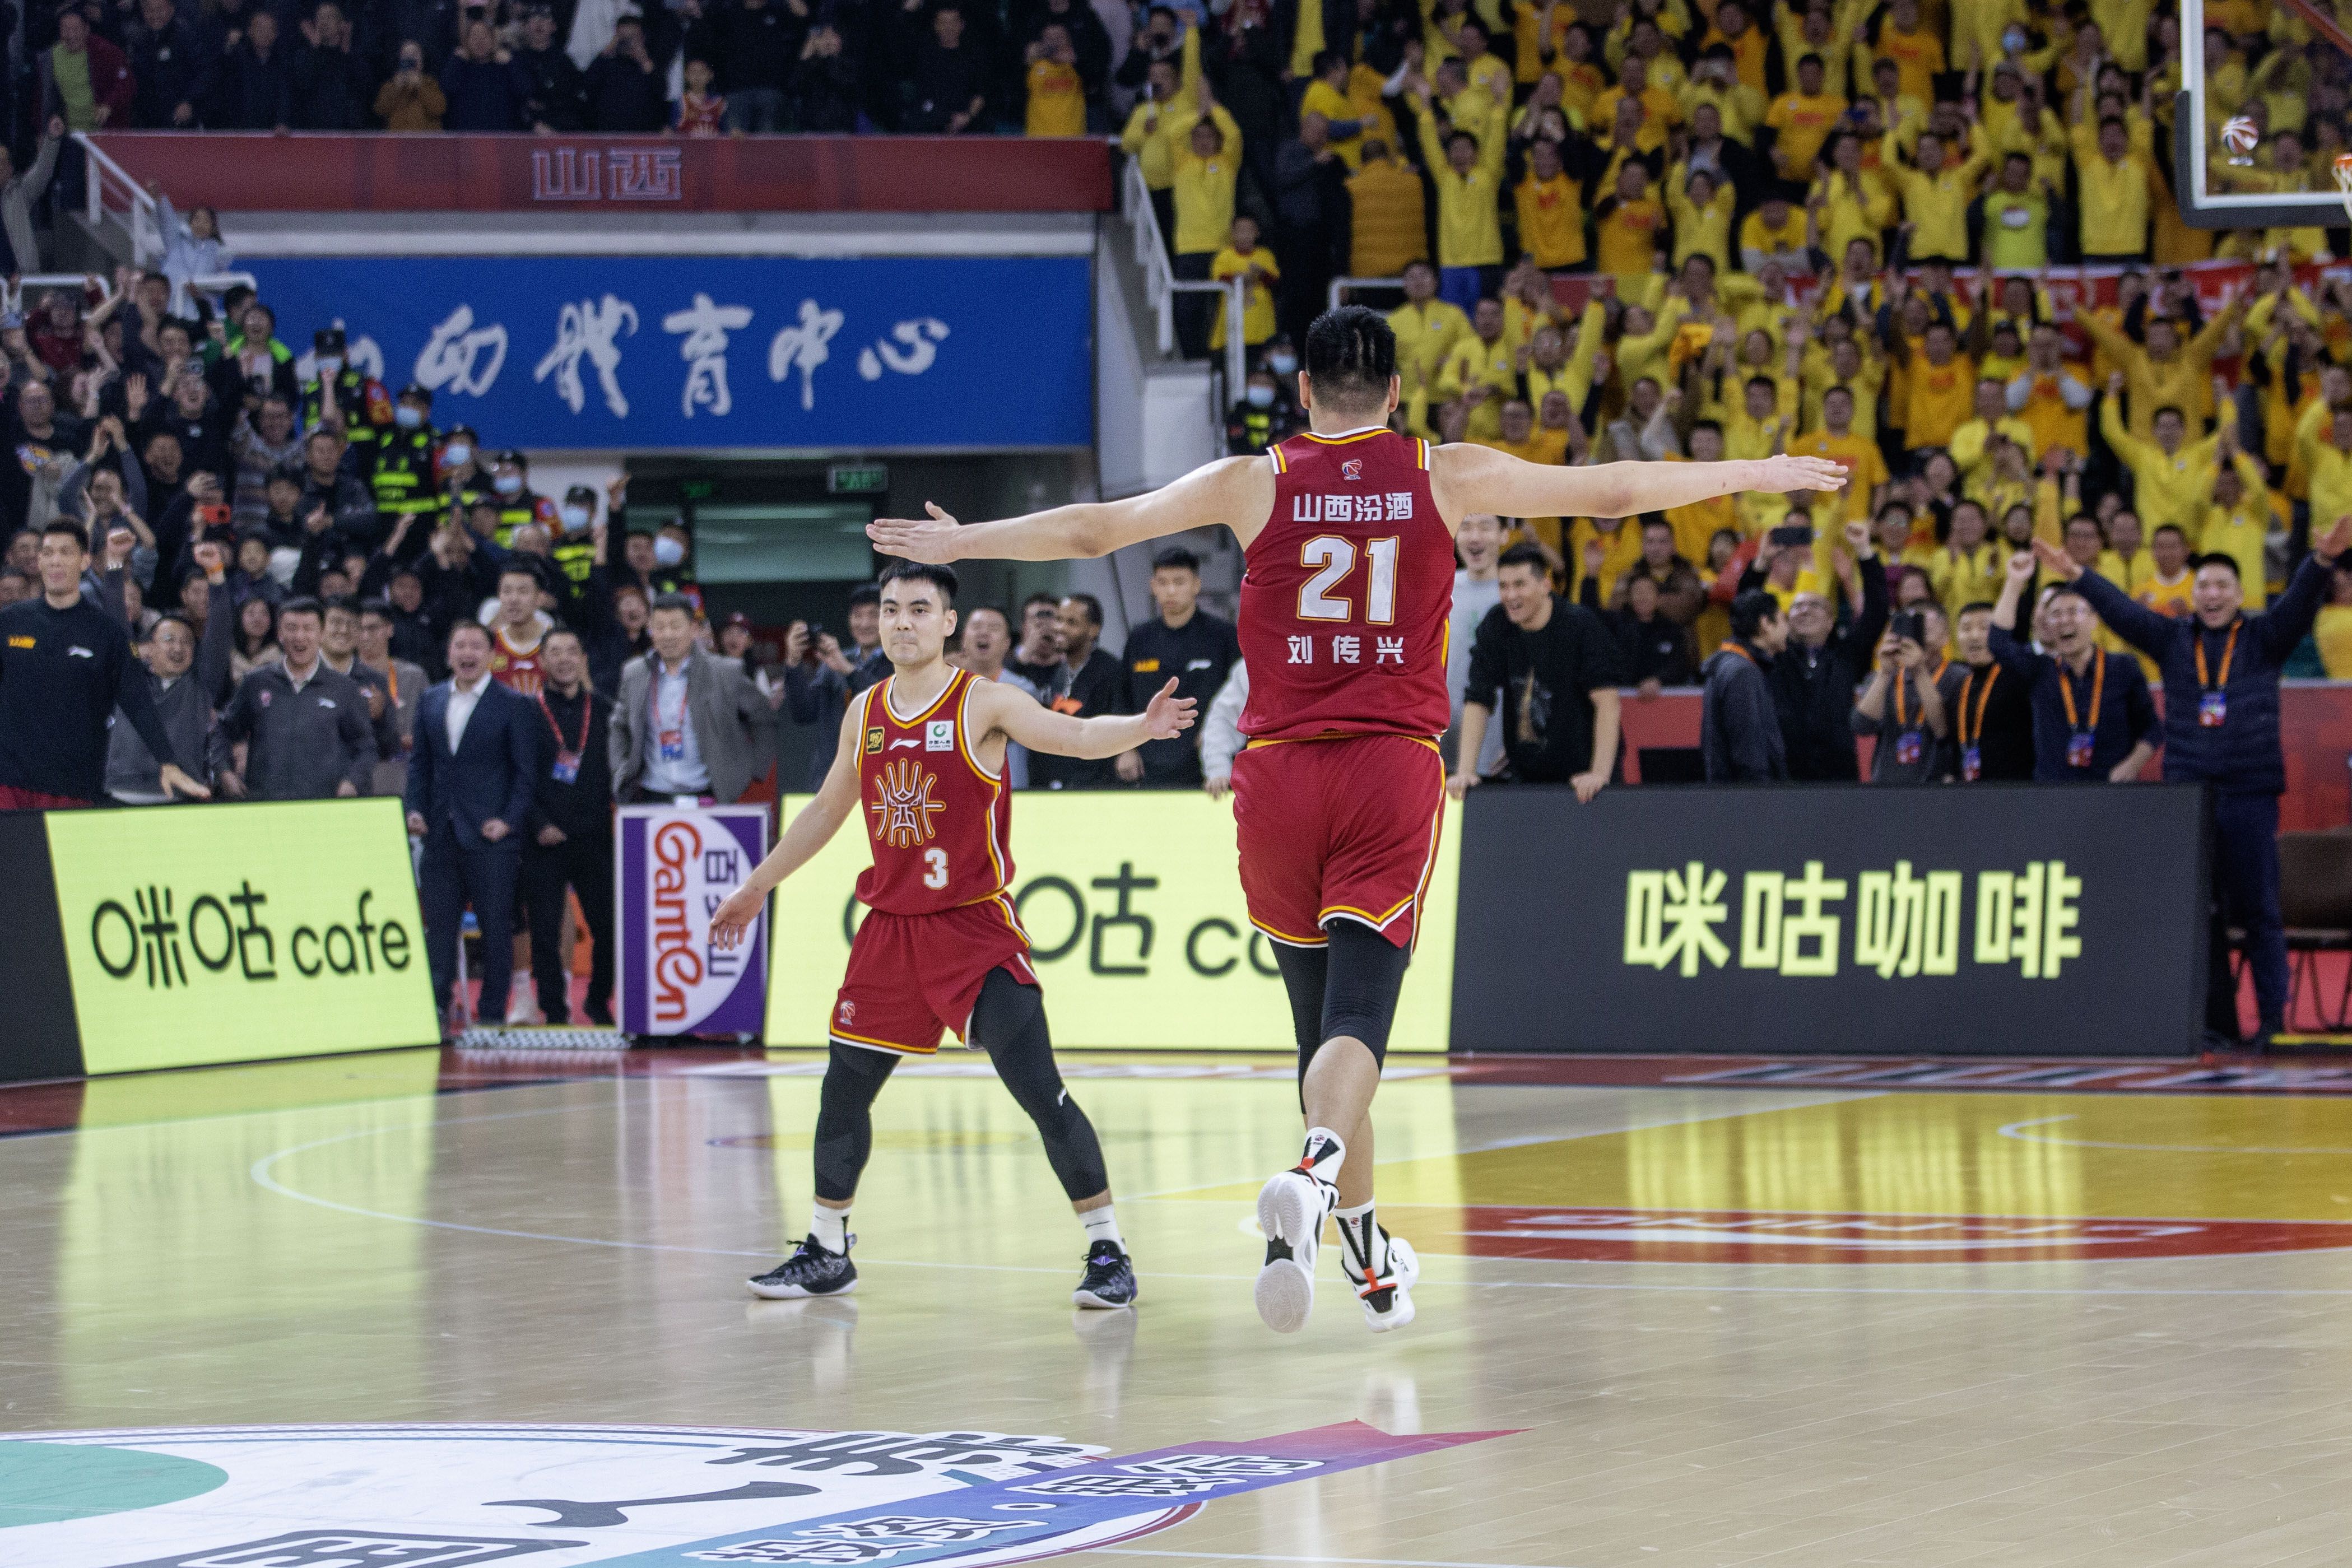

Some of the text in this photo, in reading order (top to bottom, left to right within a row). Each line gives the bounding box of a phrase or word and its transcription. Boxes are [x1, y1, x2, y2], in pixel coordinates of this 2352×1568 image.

[531, 146, 682, 201] 山西
[1293, 492, 1413, 522] 山西汾酒
[1296, 534, 1400, 626] 21
[1287, 635, 1404, 664] 刘传兴
[705, 849, 740, 979] 百山
[923, 848, 949, 890] 3
[91, 879, 412, 988] 咪咕 cafe
[654, 821, 705, 1022] Ganten
[1623, 859, 2083, 979] 咪咕咖啡
